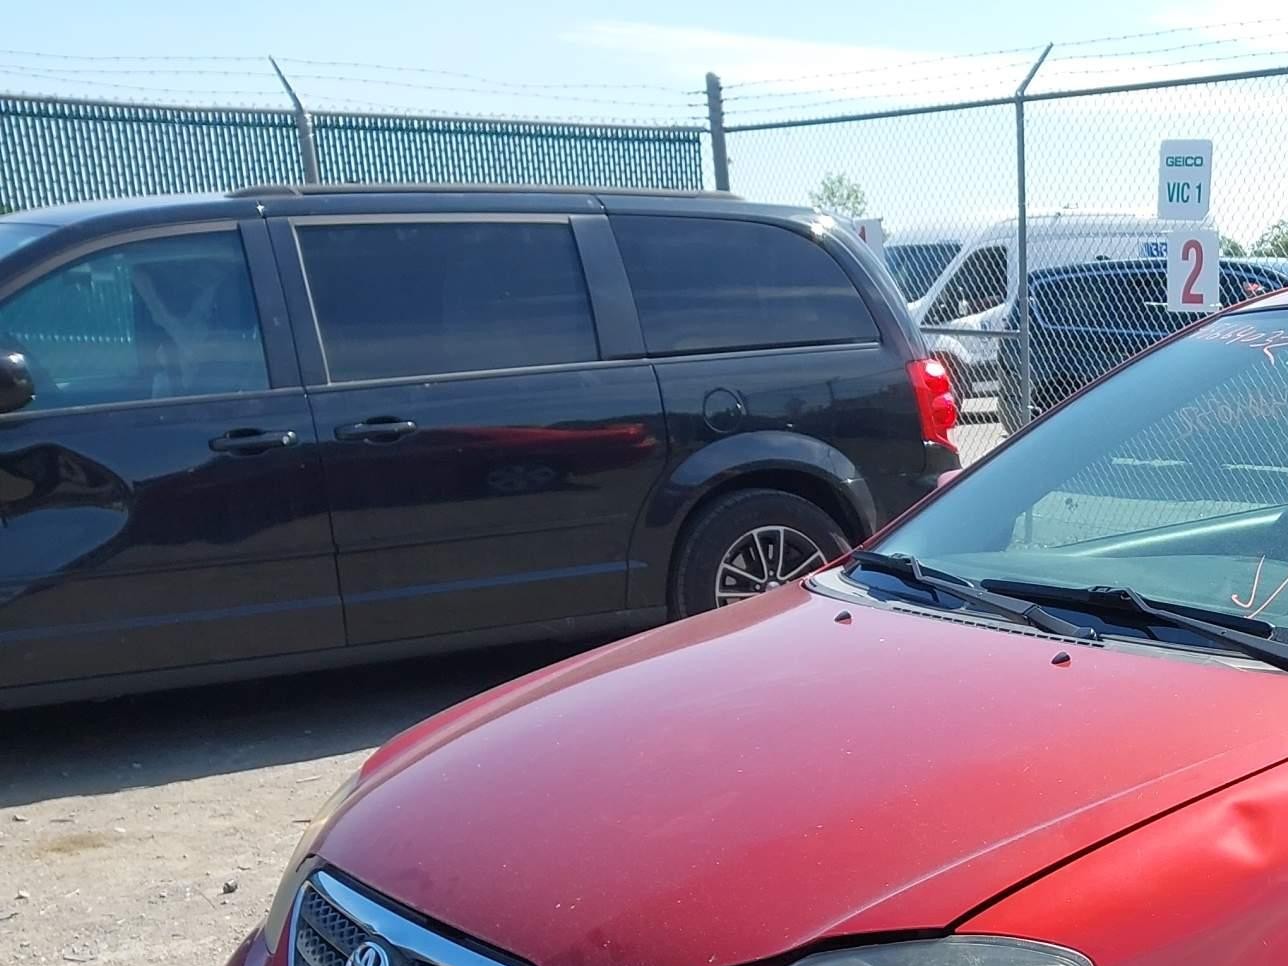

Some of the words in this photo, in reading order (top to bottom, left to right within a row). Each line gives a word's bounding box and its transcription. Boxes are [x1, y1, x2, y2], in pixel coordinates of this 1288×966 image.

[1165, 155, 1204, 167] GEICO
[1166, 181, 1190, 203] VIC
[1195, 181, 1202, 204] 1
[1181, 239, 1204, 305] 2
